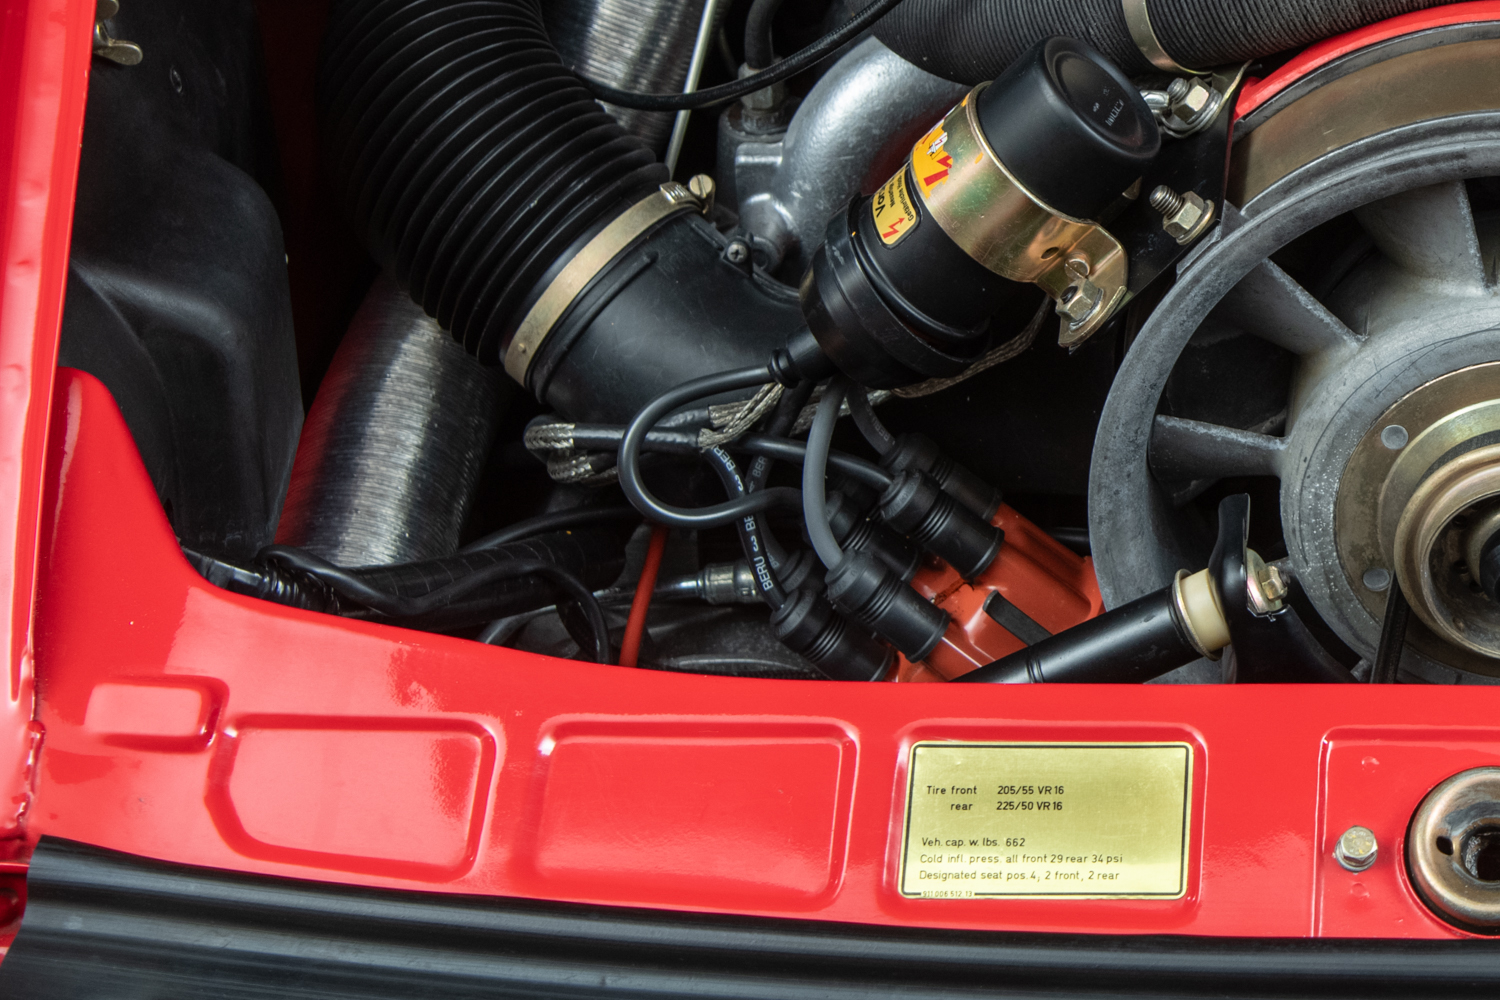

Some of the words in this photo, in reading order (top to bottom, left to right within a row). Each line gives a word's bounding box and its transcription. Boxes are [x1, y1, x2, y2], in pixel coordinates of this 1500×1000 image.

[713, 446, 736, 471] BER
[752, 456, 768, 478] BER
[754, 556, 774, 591] BERU
[927, 786, 946, 794] Tire
[951, 786, 978, 794] front
[997, 786, 1034, 795] 205/55
[950, 803, 973, 811] rear
[996, 802, 1034, 811] 225/50
[922, 838, 943, 847] Veh.
[946, 839, 966, 848] cap.
[969, 839, 980, 847] w.
[982, 838, 1000, 847] lbs.
[1005, 838, 1026, 847] 662
[920, 854, 943, 864] Cold
[947, 854, 966, 864] infl.
[969, 856, 1002, 866] press.
[1006, 854, 1018, 864] all
[1022, 854, 1048, 864] front
[1050, 854, 1064, 864] 29
[1066, 856, 1088, 864] rear
[1092, 854, 1104, 864] 34
[1106, 854, 1124, 865] psi
[919, 870, 976, 882] Designated
[980, 871, 1003, 880] seat
[1044, 870, 1051, 880] 2
[1054, 870, 1084, 882] front,
[1088, 870, 1095, 880] 2
[1097, 872, 1120, 880] rear
